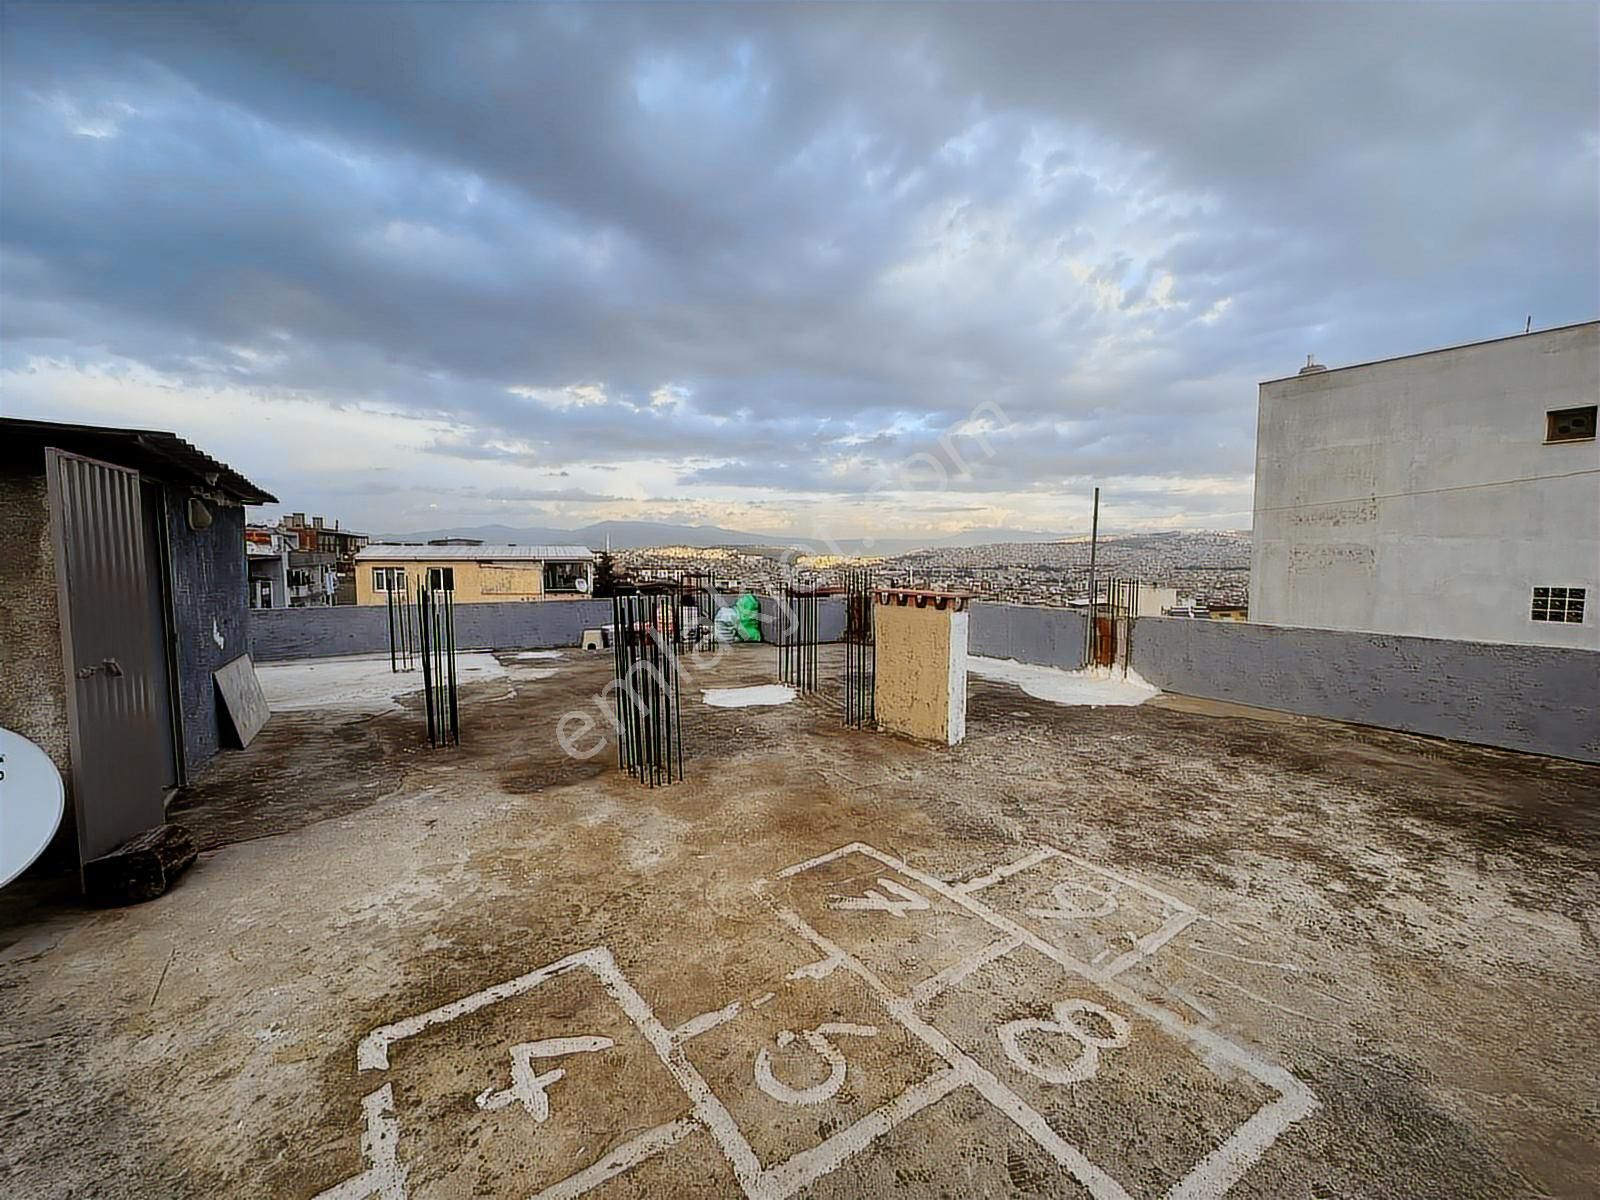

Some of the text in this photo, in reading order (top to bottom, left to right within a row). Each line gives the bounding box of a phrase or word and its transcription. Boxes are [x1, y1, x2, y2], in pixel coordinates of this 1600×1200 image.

[475, 1035, 614, 1123] 4
[754, 1021, 878, 1105] 5
[998, 998, 1131, 1085] 8
